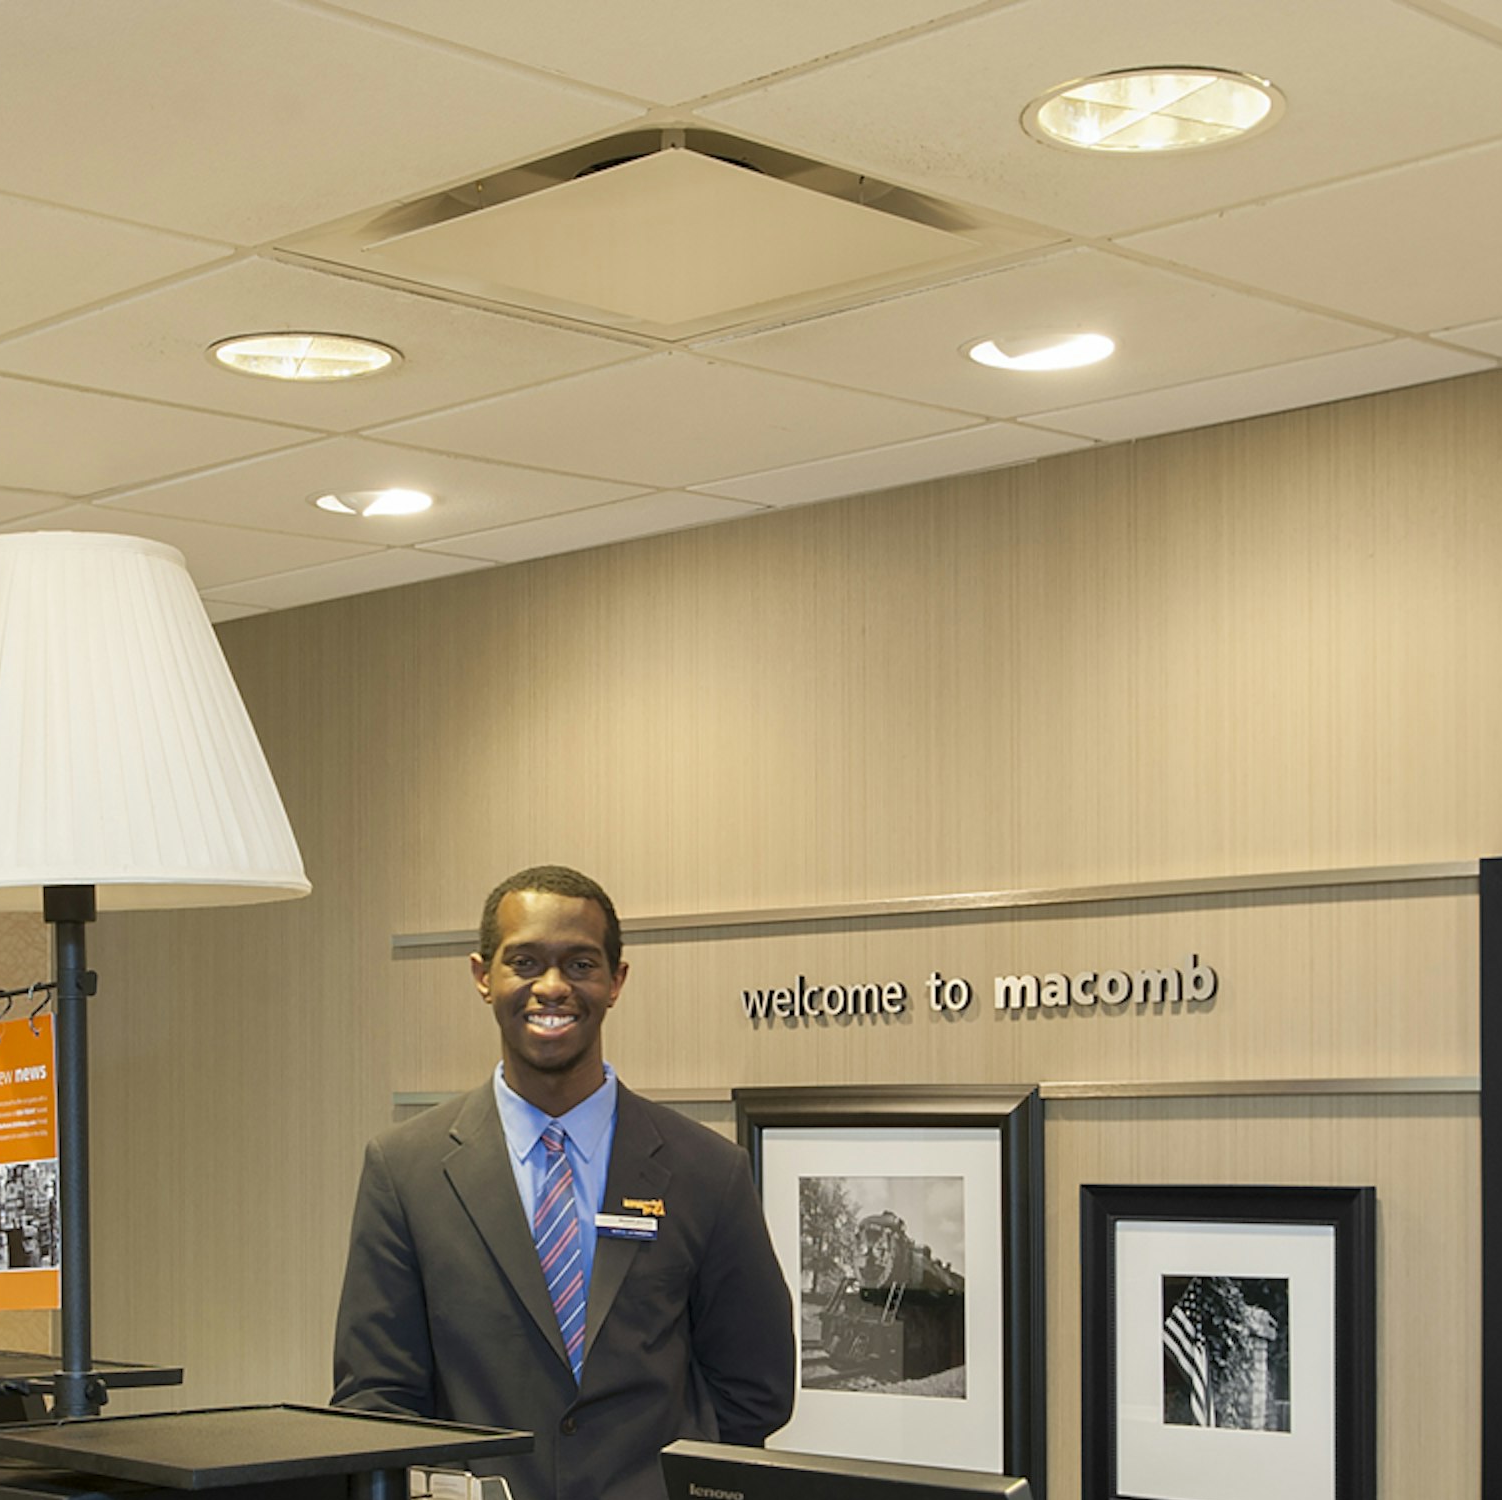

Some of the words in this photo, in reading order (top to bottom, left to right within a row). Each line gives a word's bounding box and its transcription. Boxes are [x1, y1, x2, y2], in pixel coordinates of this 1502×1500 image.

[741, 973, 907, 1019] welcome
[925, 971, 971, 1012] to
[993, 954, 1220, 1010] macomb
[14, 1064, 48, 1083] news
